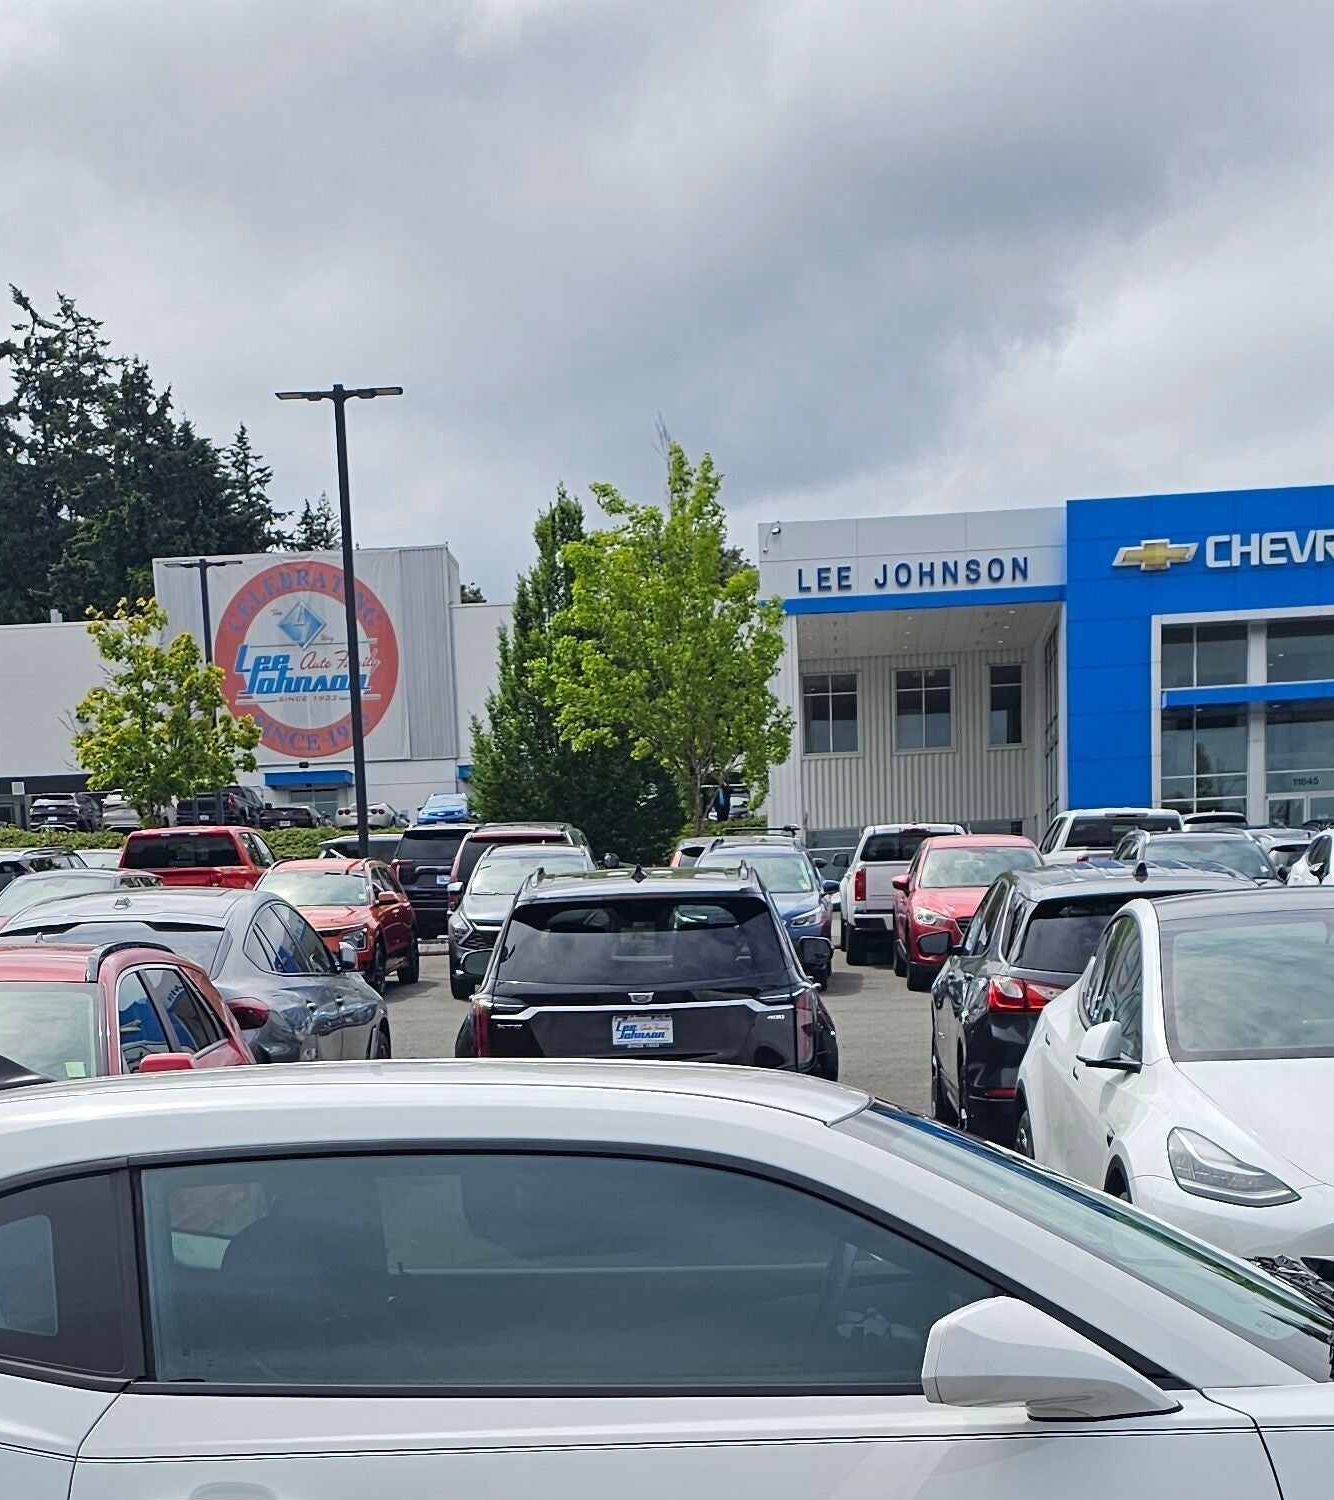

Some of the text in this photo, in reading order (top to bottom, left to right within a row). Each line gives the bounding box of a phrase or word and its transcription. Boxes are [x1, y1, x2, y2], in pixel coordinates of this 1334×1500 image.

[797, 557, 1028, 592] LEE JOHNSON
[228, 569, 378, 634] CELEBRATNG
[235, 645, 380, 675] Lee Auto Fily
[237, 664, 369, 694] Johnson
[278, 694, 307, 702] SINCE
[616, 1020, 637, 1032] Lee
[617, 1029, 665, 1040] Johnson
